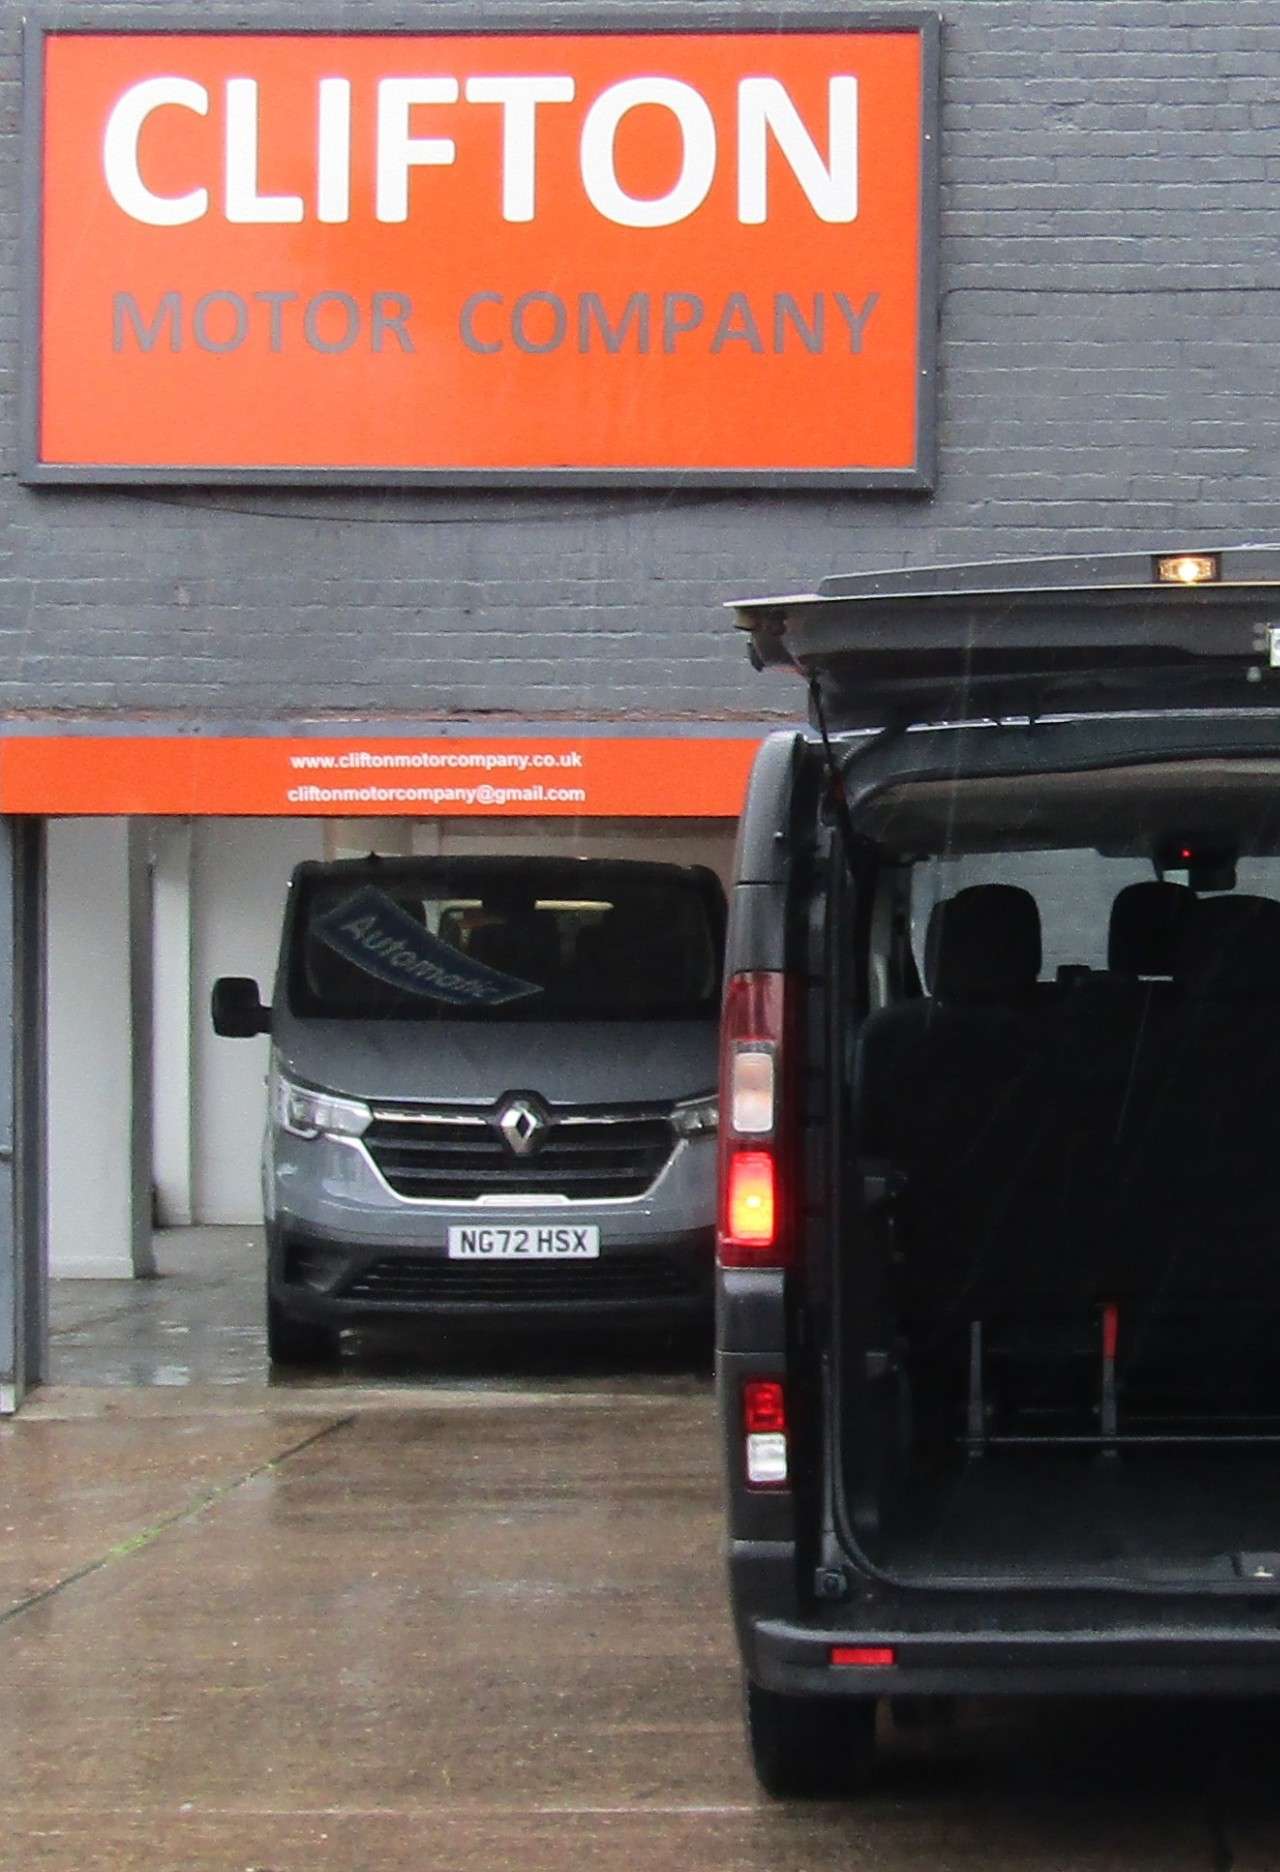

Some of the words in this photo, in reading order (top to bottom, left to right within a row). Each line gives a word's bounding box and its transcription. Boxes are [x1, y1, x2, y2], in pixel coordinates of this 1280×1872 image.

[103, 76, 858, 227] CLIFTON
[110, 291, 415, 354] MOTOR
[457, 290, 881, 355] COMPANY
[291, 752, 582, 769] www.cliftonmotorcompany.co.uk
[288, 785, 586, 804] cliftonmotorcompany@gmail.com
[461, 1230, 529, 1253] NG72
[538, 1230, 588, 1253] HSX
